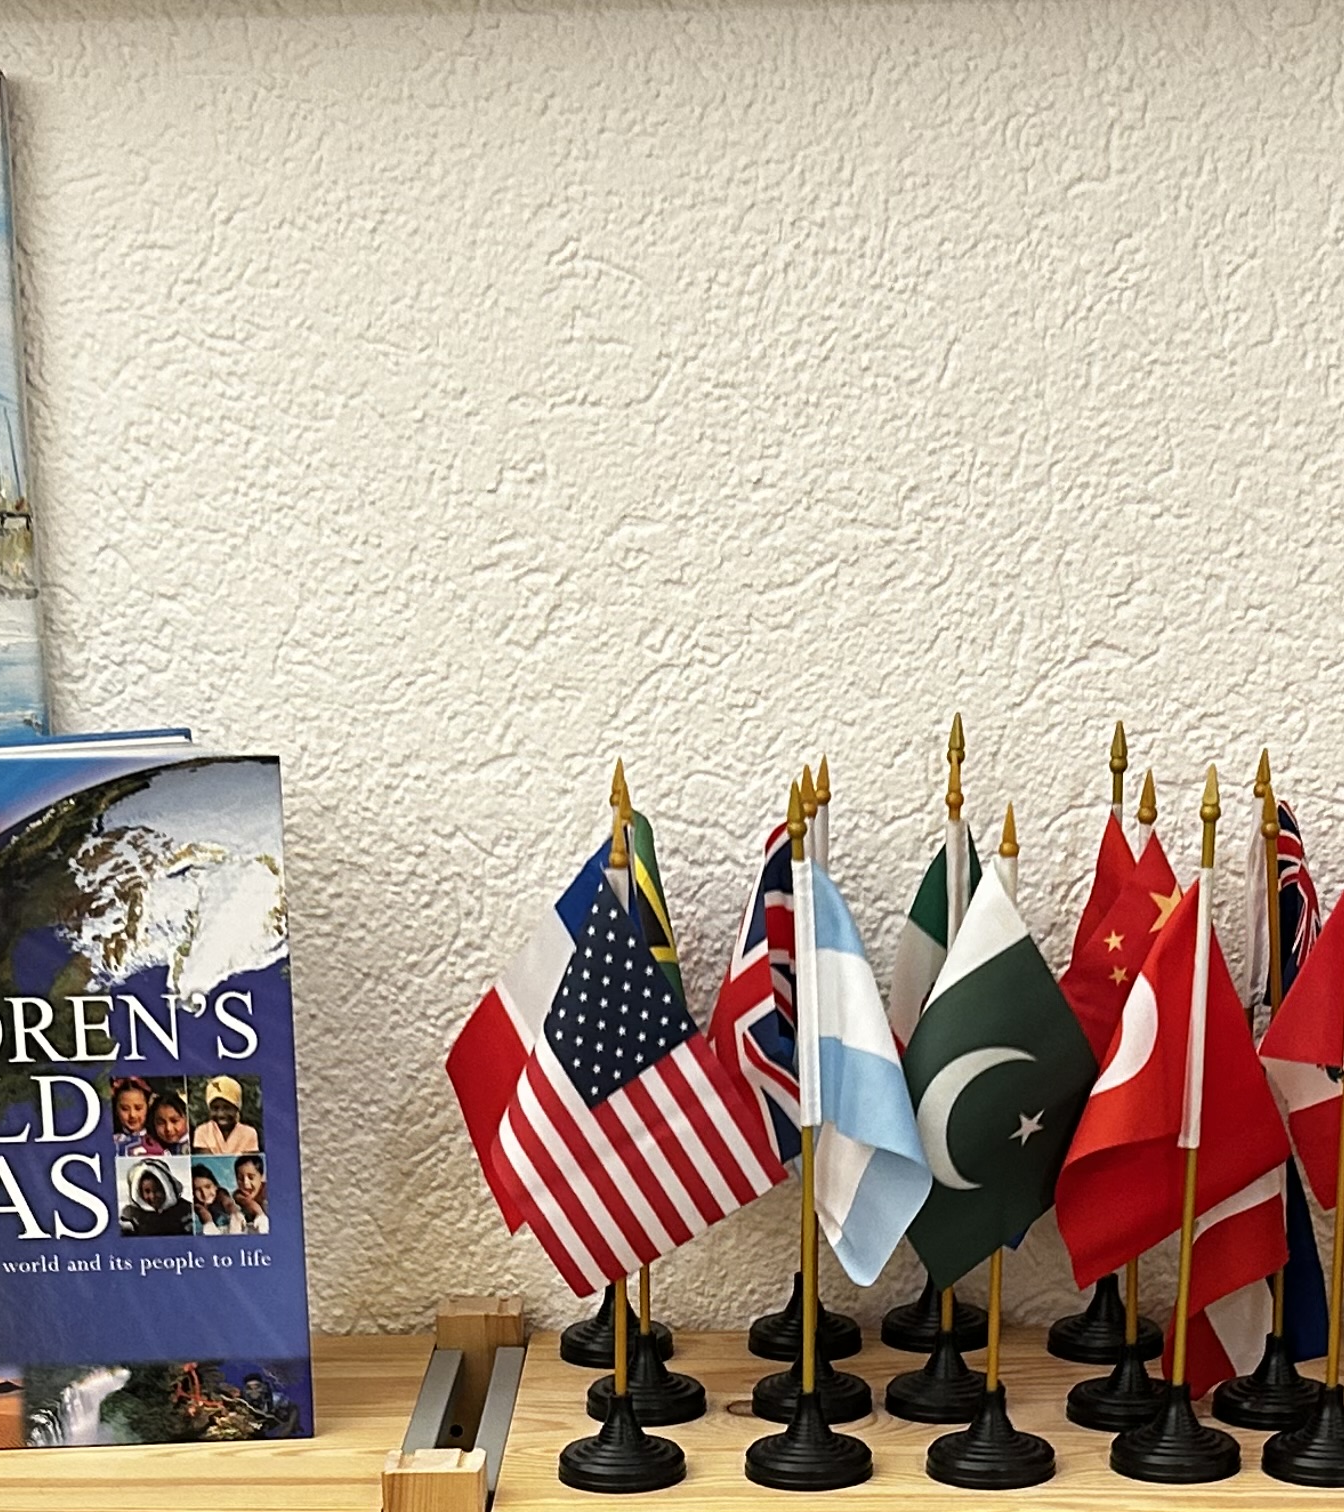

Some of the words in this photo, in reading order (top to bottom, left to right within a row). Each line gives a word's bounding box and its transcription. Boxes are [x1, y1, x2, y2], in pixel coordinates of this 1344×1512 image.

[2, 1254, 60, 1273] world
[66, 1253, 102, 1272] and
[108, 1253, 133, 1272] its
[140, 1250, 205, 1277] people
[212, 1252, 233, 1268] to
[239, 1248, 273, 1268] life
